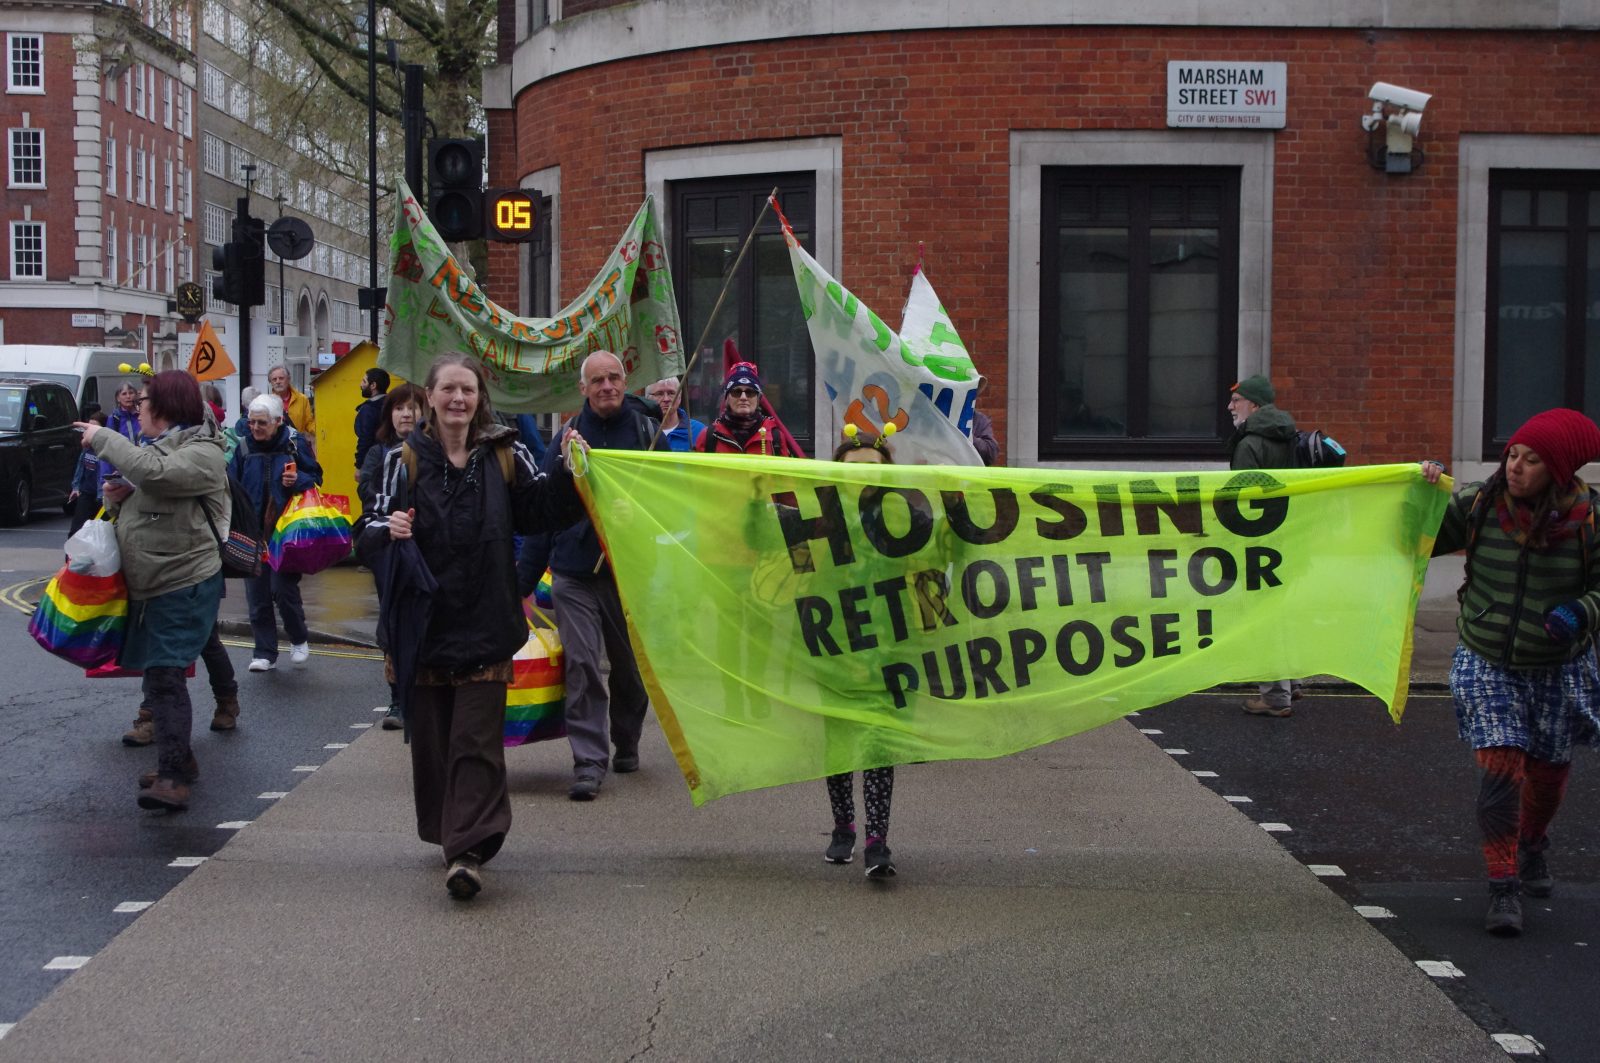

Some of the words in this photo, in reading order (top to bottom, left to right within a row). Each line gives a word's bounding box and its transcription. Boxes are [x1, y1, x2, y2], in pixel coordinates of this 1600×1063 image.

[1178, 68, 1263, 85] MARSHAM
[1178, 89, 1238, 105] STREET
[1244, 89, 1276, 106] SW1
[1177, 114, 1194, 123] CITY
[1197, 115, 1206, 123] OF
[1208, 115, 1261, 124] WESTMINSTER
[497, 201, 530, 228] 05
[770, 471, 1289, 574] HOUSING
[794, 551, 1112, 657] RETROFIT
[1147, 546, 1283, 599] FOR
[881, 609, 1214, 709] PURPOSE!
